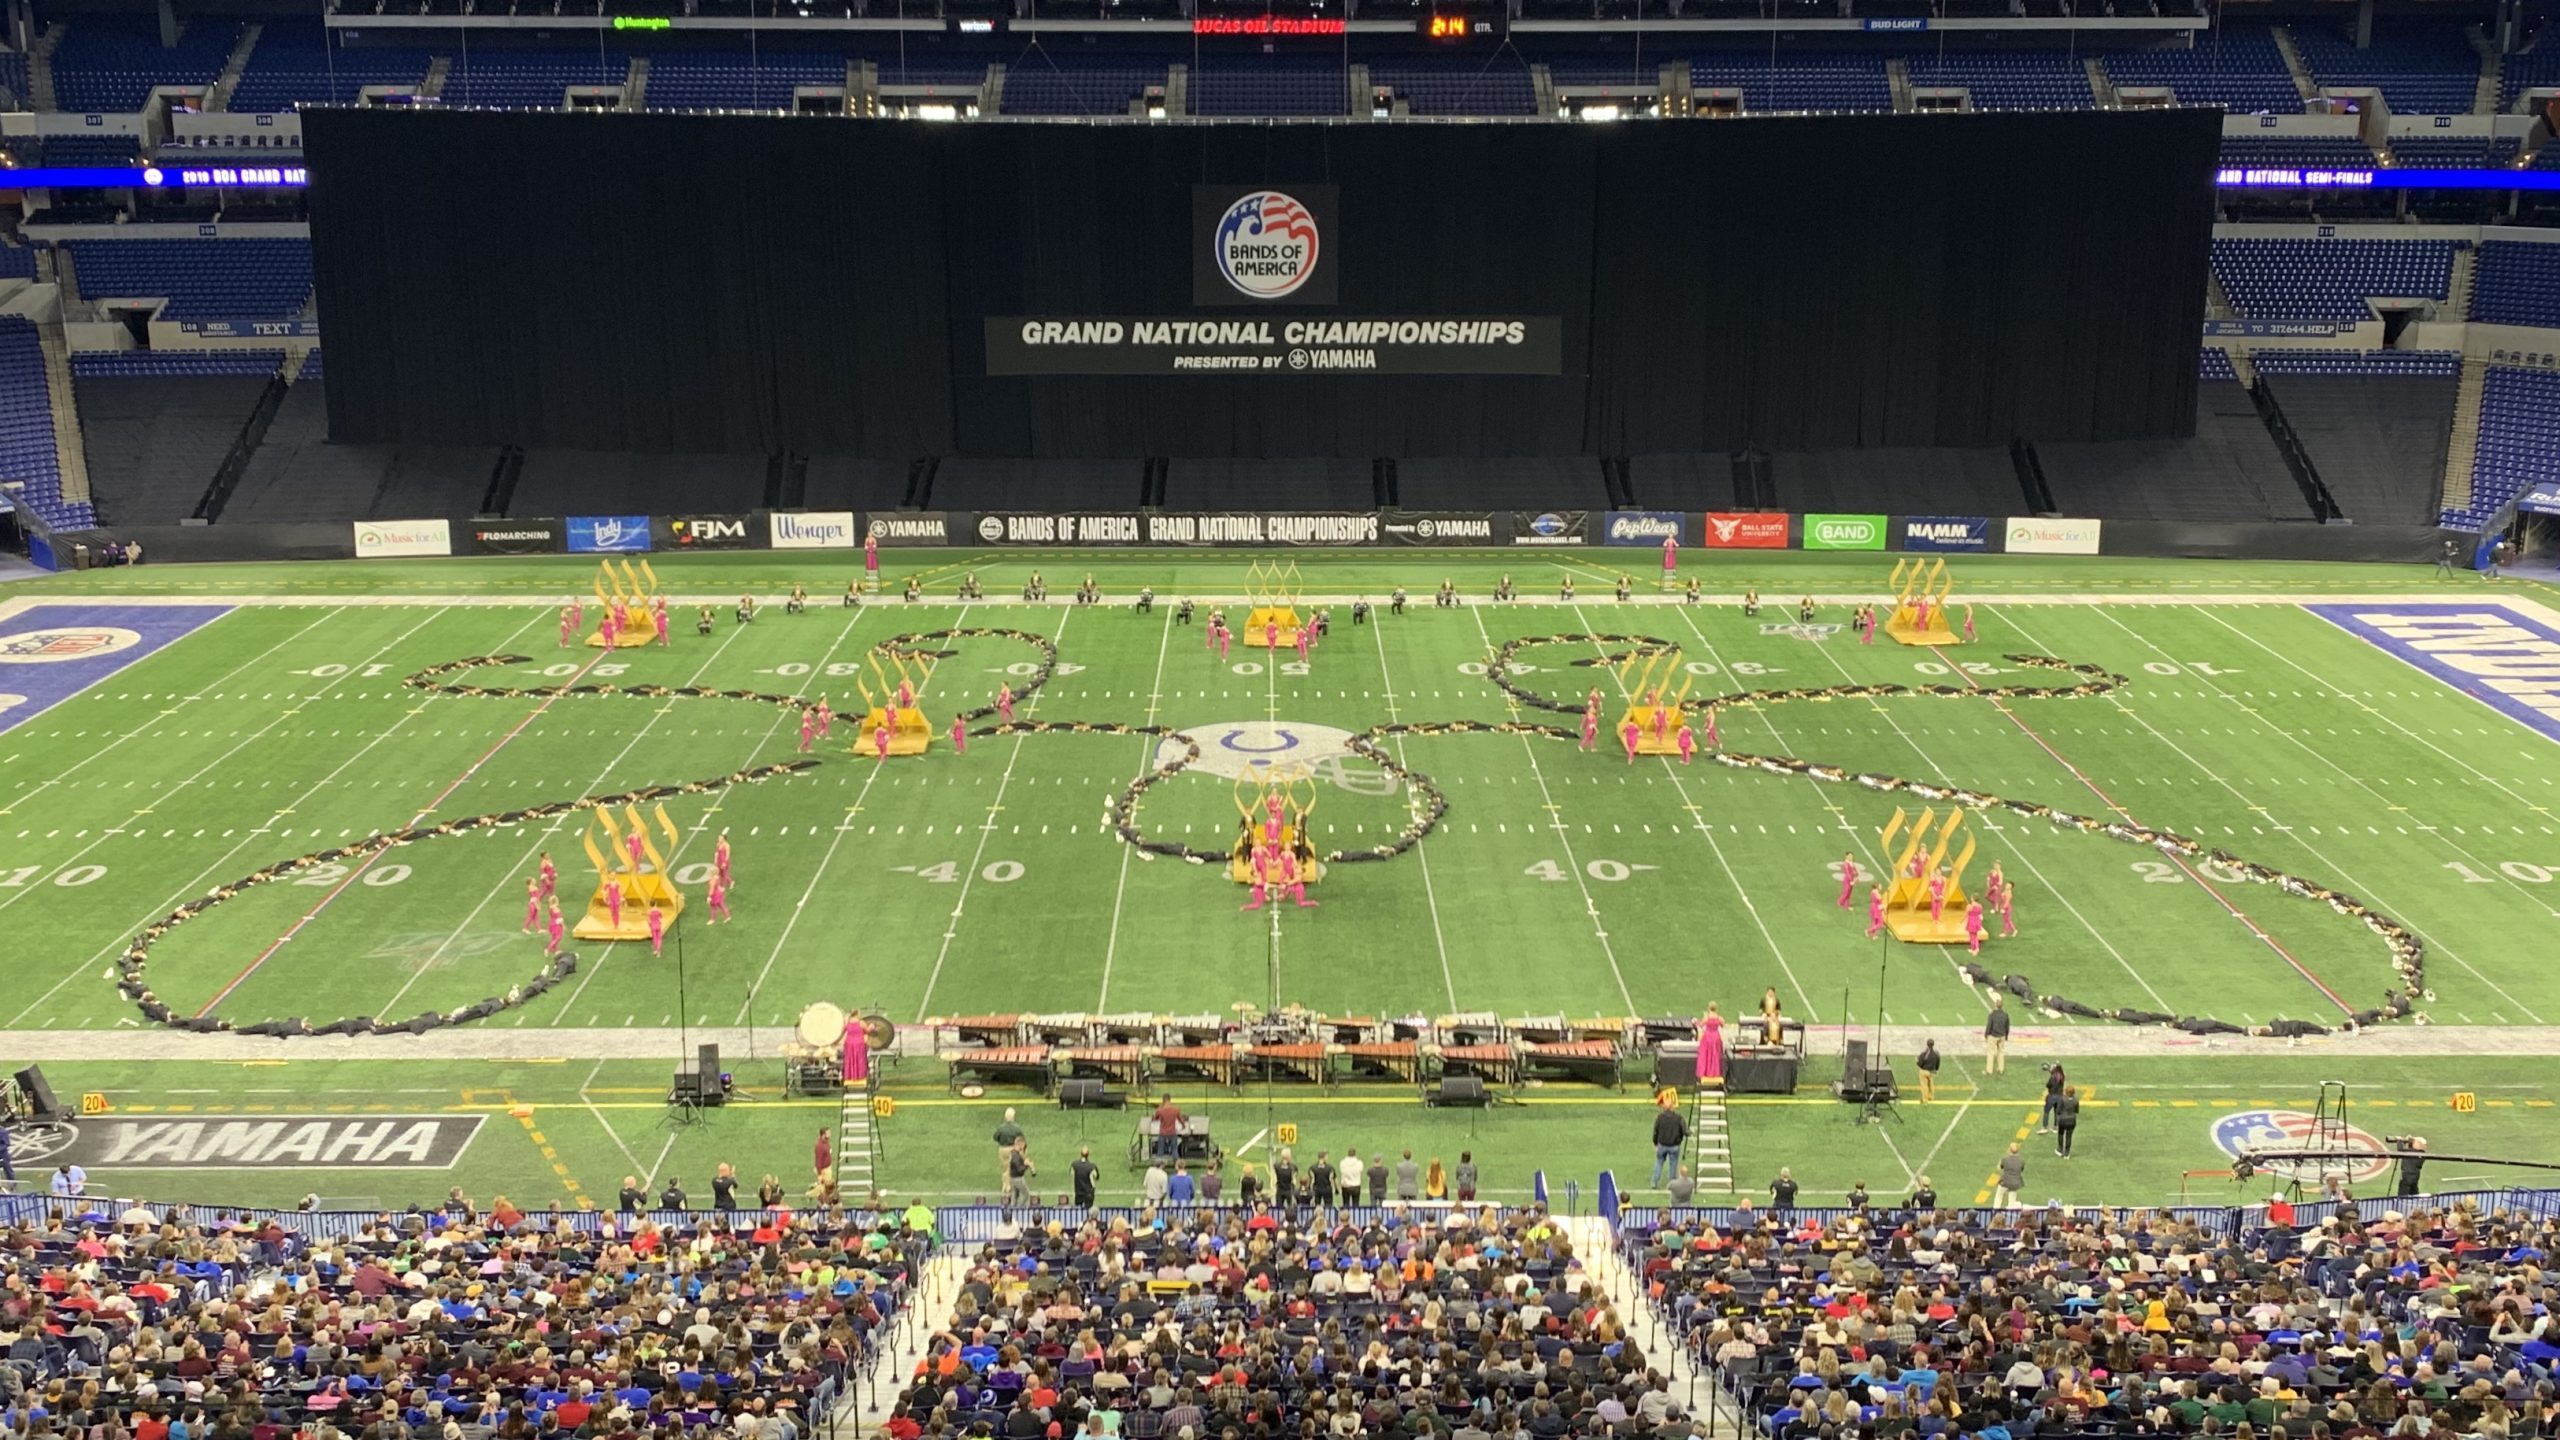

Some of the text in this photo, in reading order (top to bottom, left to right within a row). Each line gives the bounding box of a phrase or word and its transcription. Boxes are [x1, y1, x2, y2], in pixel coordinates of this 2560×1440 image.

[626, 17, 669, 29] Huntington
[959, 21, 990, 32] verizon
[1194, 21, 1344, 33] LUCAS OIL STADIUM
[1870, 20, 1921, 29] BUD LIGHT
[241, 169, 281, 183] GRAND
[2246, 170, 2301, 183] NATIONAL
[2306, 172, 2373, 184] SEMI-FINALS
[1230, 245, 1302, 259] BANDS OF
[1235, 261, 1298, 276] AMERICA
[252, 323, 291, 334] TEXT
[1022, 321, 1525, 344] GRAND NATIONAL CHAMPIONSHIPS
[1174, 349, 1377, 369] PRESENTED BY YAMAHA
[594, 518, 621, 546] Indy
[691, 520, 745, 537] FJM
[778, 516, 846, 545] Wenger
[888, 520, 945, 536] YAMAHA
[1009, 517, 1378, 540] BANDS OF AMERICA GRAND NATIONAL CHAMPIONSHIPS
[1435, 520, 1490, 536] YAMAHA
[1612, 517, 1678, 539] PepWear
[1822, 526, 1868, 539] BAND
[1908, 523, 1967, 540] NAMM
[384, 531, 446, 543] Music for All
[483, 531, 550, 540] FLOMARCHING
[2034, 530, 2096, 541] Music for All
[85, 1096, 99, 1110] 20
[875, 1100, 889, 1114] 40
[2459, 1095, 2473, 1110] 20
[1280, 1127, 1295, 1141] 50
[102, 1121, 441, 1162] YAMAHA
